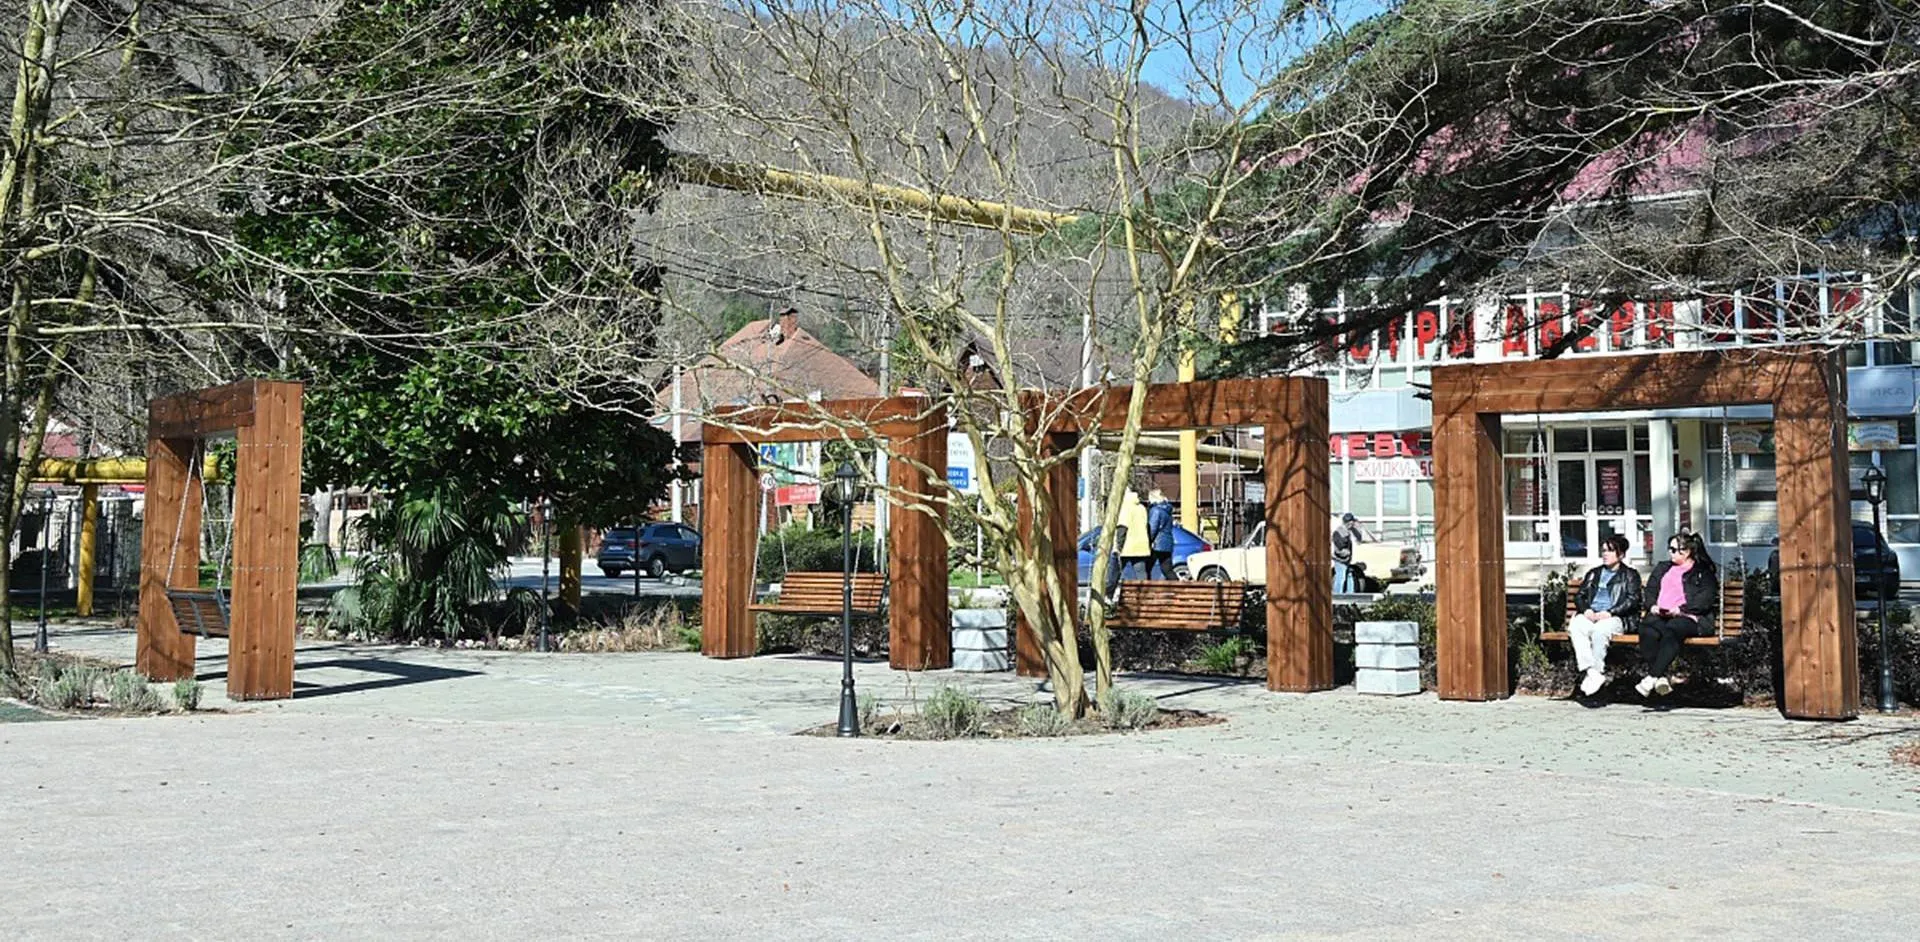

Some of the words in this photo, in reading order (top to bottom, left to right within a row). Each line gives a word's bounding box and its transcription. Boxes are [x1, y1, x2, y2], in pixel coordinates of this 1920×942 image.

[1502, 300, 1675, 357] ДВЕРИ
[1329, 432, 1432, 459] ЕБЕ
[1356, 461, 1410, 478] СКИДКИ
